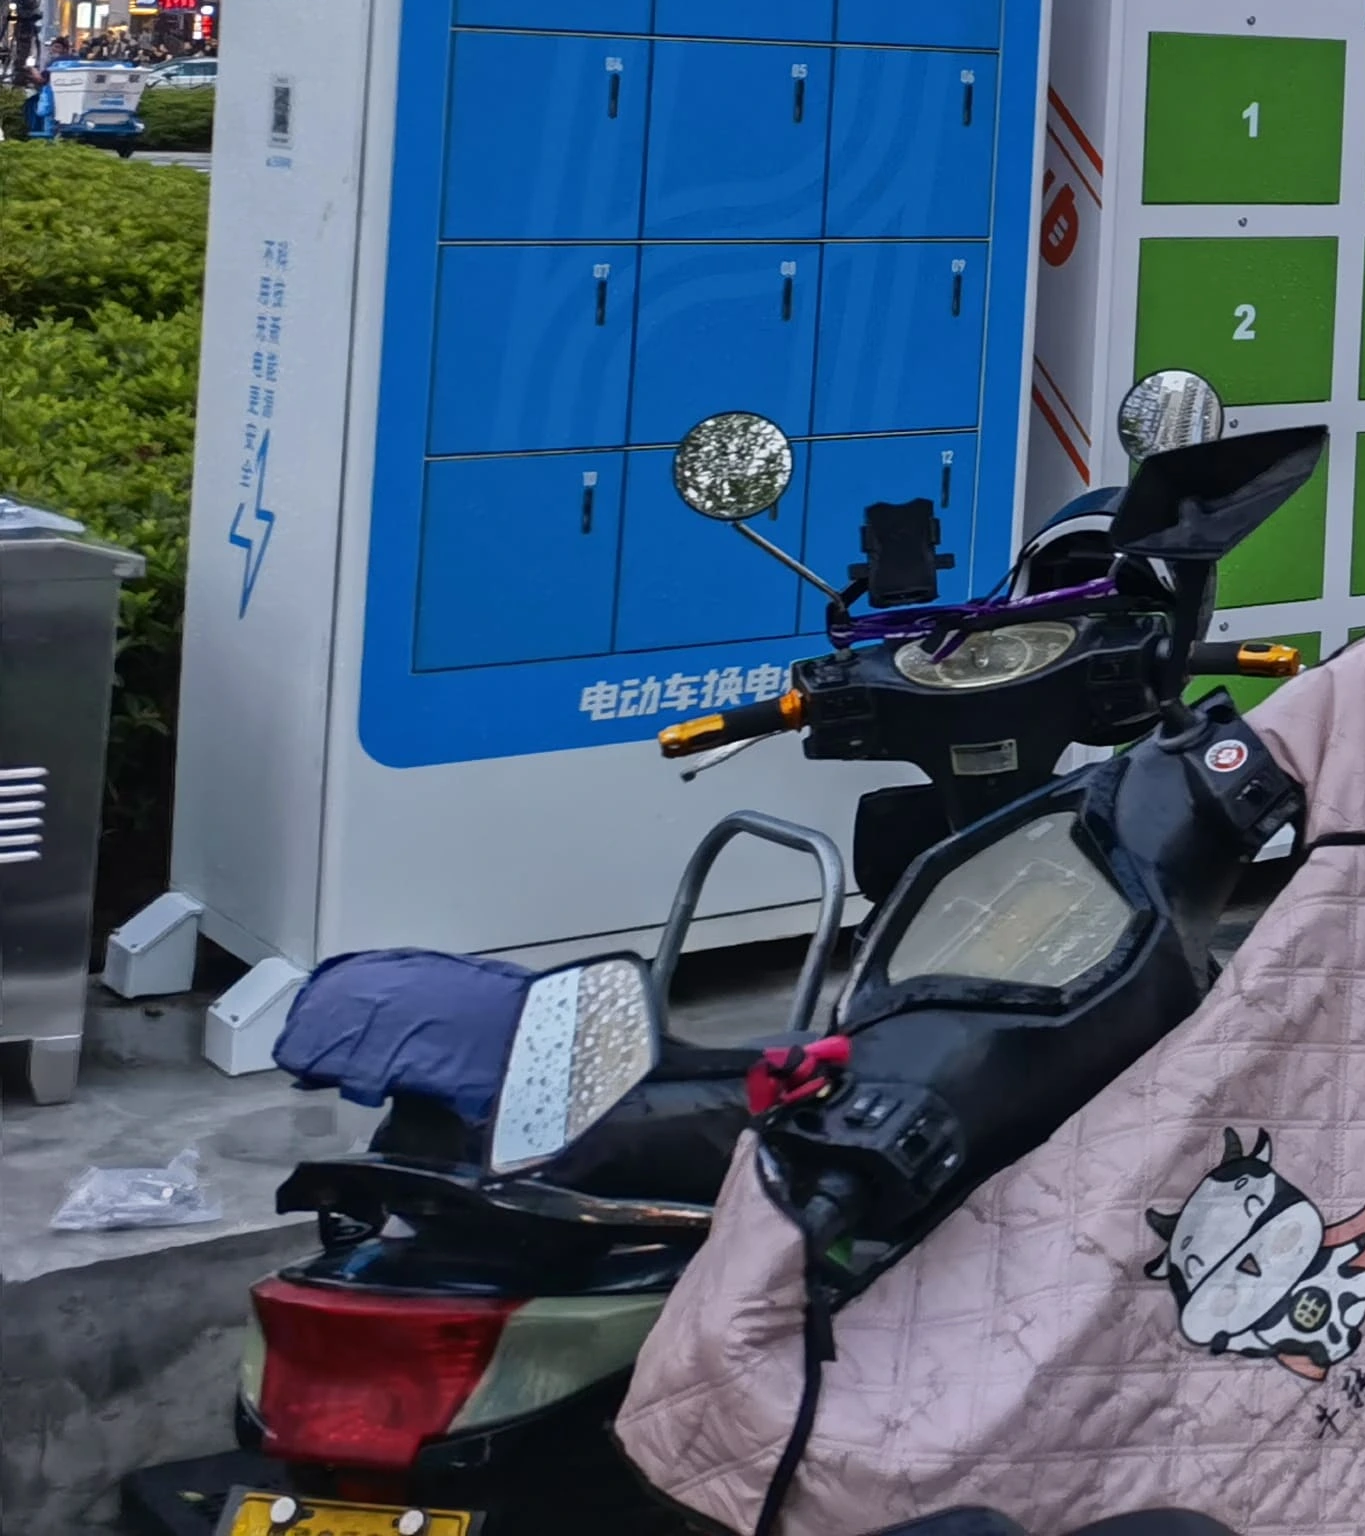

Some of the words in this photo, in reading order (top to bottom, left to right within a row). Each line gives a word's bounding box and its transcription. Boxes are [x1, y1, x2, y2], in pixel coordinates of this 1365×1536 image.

[1241, 101, 1260, 139] 1
[1232, 303, 1256, 340] 2
[1293, 1291, 1327, 1329] 旺
